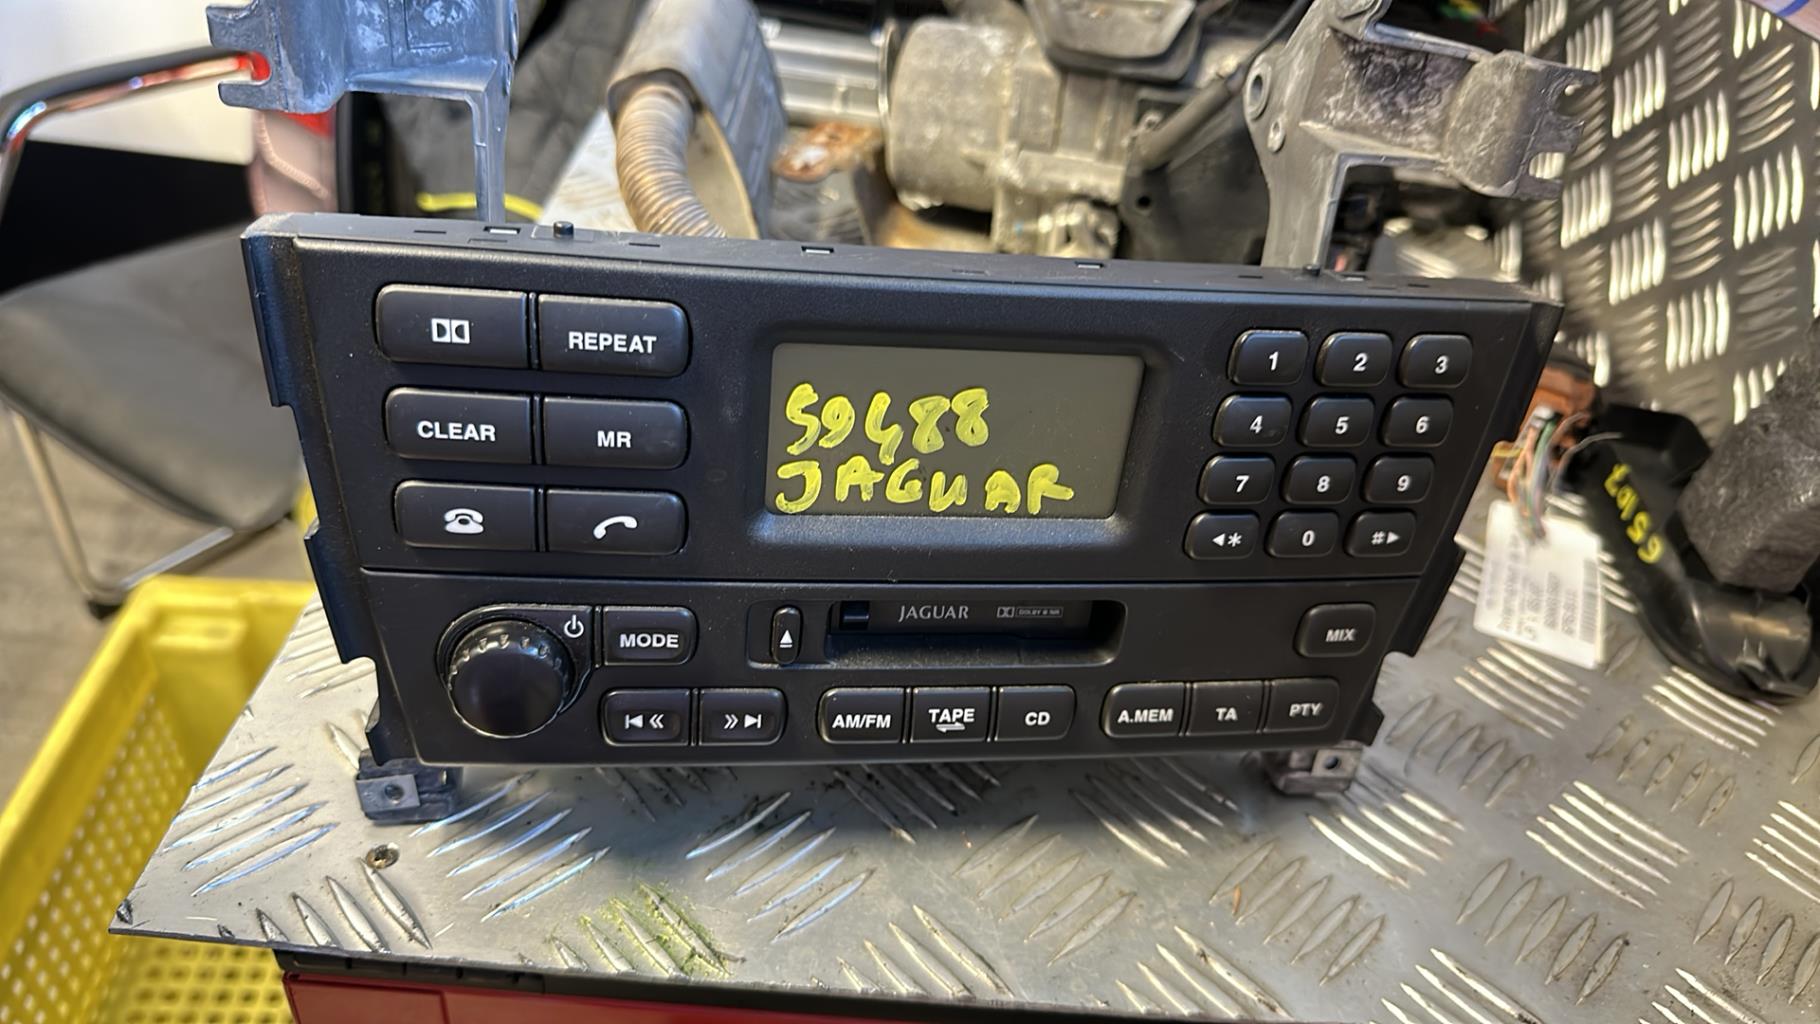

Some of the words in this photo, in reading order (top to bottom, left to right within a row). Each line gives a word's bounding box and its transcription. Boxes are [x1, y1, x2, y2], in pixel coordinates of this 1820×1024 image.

[568, 331, 657, 354] REPEAT
[1269, 351, 1279, 371] 1
[1353, 352, 1368, 372] 2
[1435, 355, 1448, 374] 3
[417, 420, 496, 442] CLEAR
[1250, 415, 1263, 434] 4
[1335, 416, 1349, 434] 5
[1416, 416, 1429, 434] 6
[597, 430, 632, 448] MR
[775, 454, 1075, 515] JAGUAR
[1236, 475, 1250, 493] 7
[1316, 475, 1330, 493] 8
[1397, 475, 1410, 492] 9
[1302, 530, 1315, 547] 0
[898, 605, 969, 623] JAGUAR
[620, 633, 679, 648] MODE
[1325, 628, 1355, 642] MIX
[928, 708, 975, 724] TAPE
[1025, 711, 1051, 726] CD
[1117, 708, 1174, 723] A.MEM
[1215, 707, 1237, 721] TA
[1289, 702, 1321, 717] PTY
[831, 714, 891, 729] AM/FM
